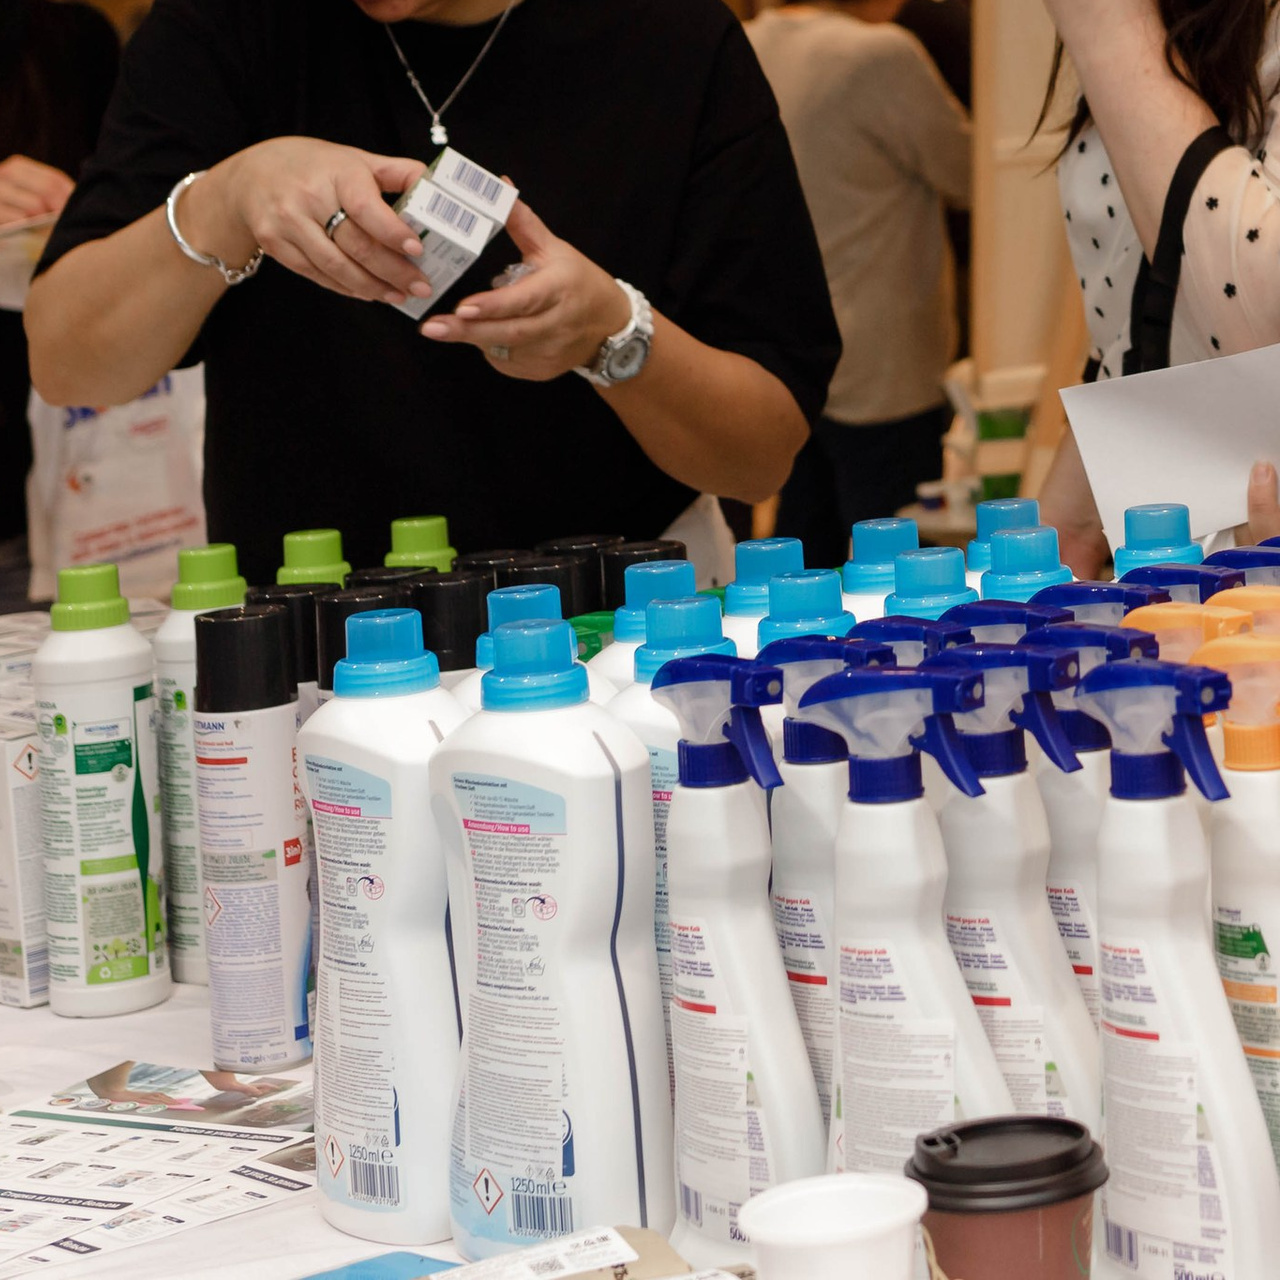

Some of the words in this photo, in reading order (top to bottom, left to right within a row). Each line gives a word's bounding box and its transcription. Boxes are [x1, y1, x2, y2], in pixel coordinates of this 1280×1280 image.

[195, 720, 225, 730] TMANN
[349, 1144, 368, 1161] 1250
[368, 1150, 380, 1163] ml
[510, 1177, 535, 1193] 1250
[536, 1181, 550, 1194] ml
